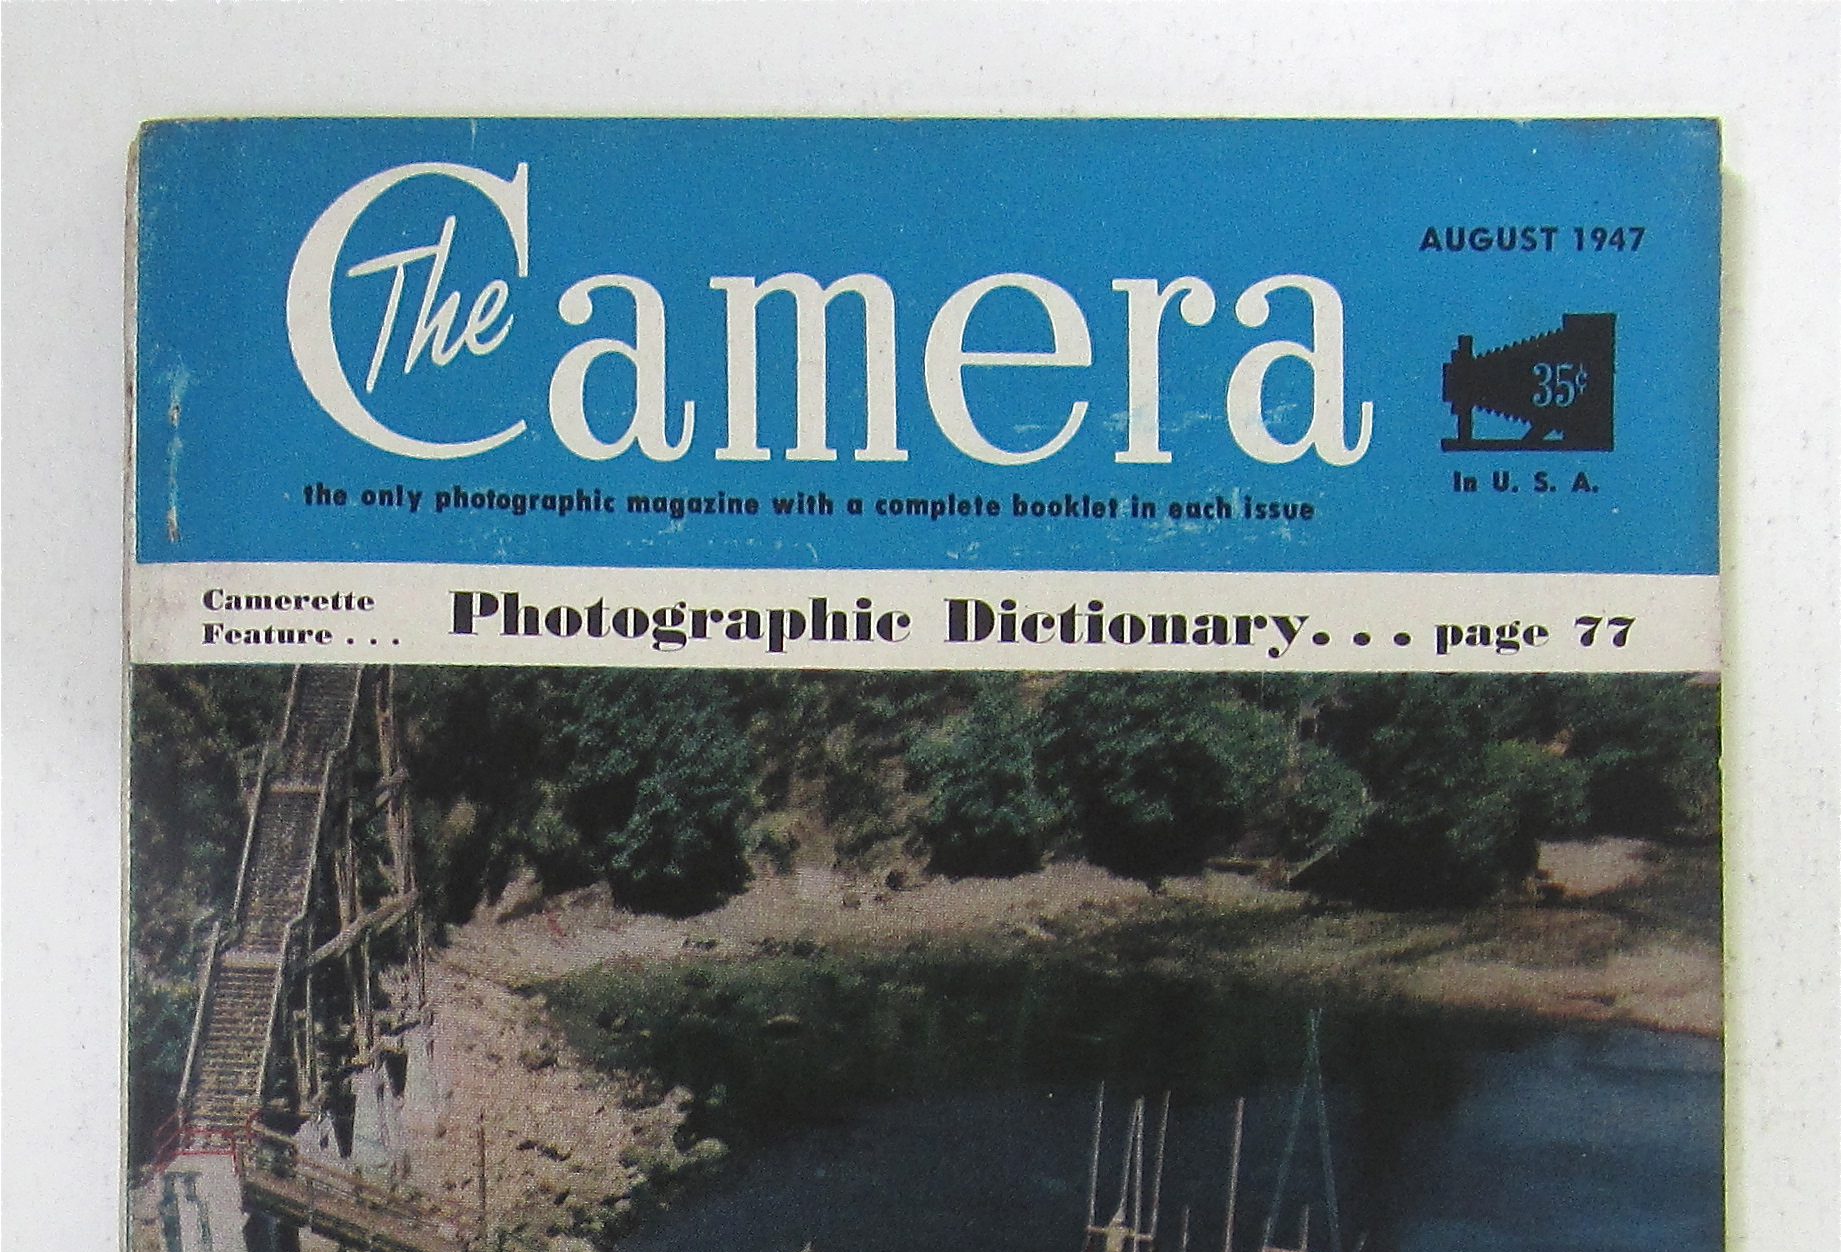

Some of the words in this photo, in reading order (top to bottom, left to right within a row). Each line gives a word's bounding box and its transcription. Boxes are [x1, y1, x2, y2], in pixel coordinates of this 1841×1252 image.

[1419, 226, 1558, 252] AUGUST
[1574, 227, 1645, 251] 1947
[286, 162, 1373, 466] Camera
[348, 216, 513, 393] The
[1533, 363, 1587, 407] 35¢
[304, 482, 347, 506] the
[361, 485, 422, 513] only
[436, 486, 614, 517] photographic
[627, 491, 759, 520] magazine
[772, 491, 833, 515] with
[847, 499, 862, 515] a
[876, 493, 1000, 522] complete
[1013, 493, 1118, 518] booklet
[1132, 494, 1155, 519] in
[1169, 496, 1231, 520] each
[1244, 494, 1314, 521] issue
[1454, 471, 1477, 492] In
[203, 589, 374, 610] Camerette
[449, 592, 910, 652] Photographic
[1437, 621, 1548, 655] page
[1575, 616, 1635, 647] 77
